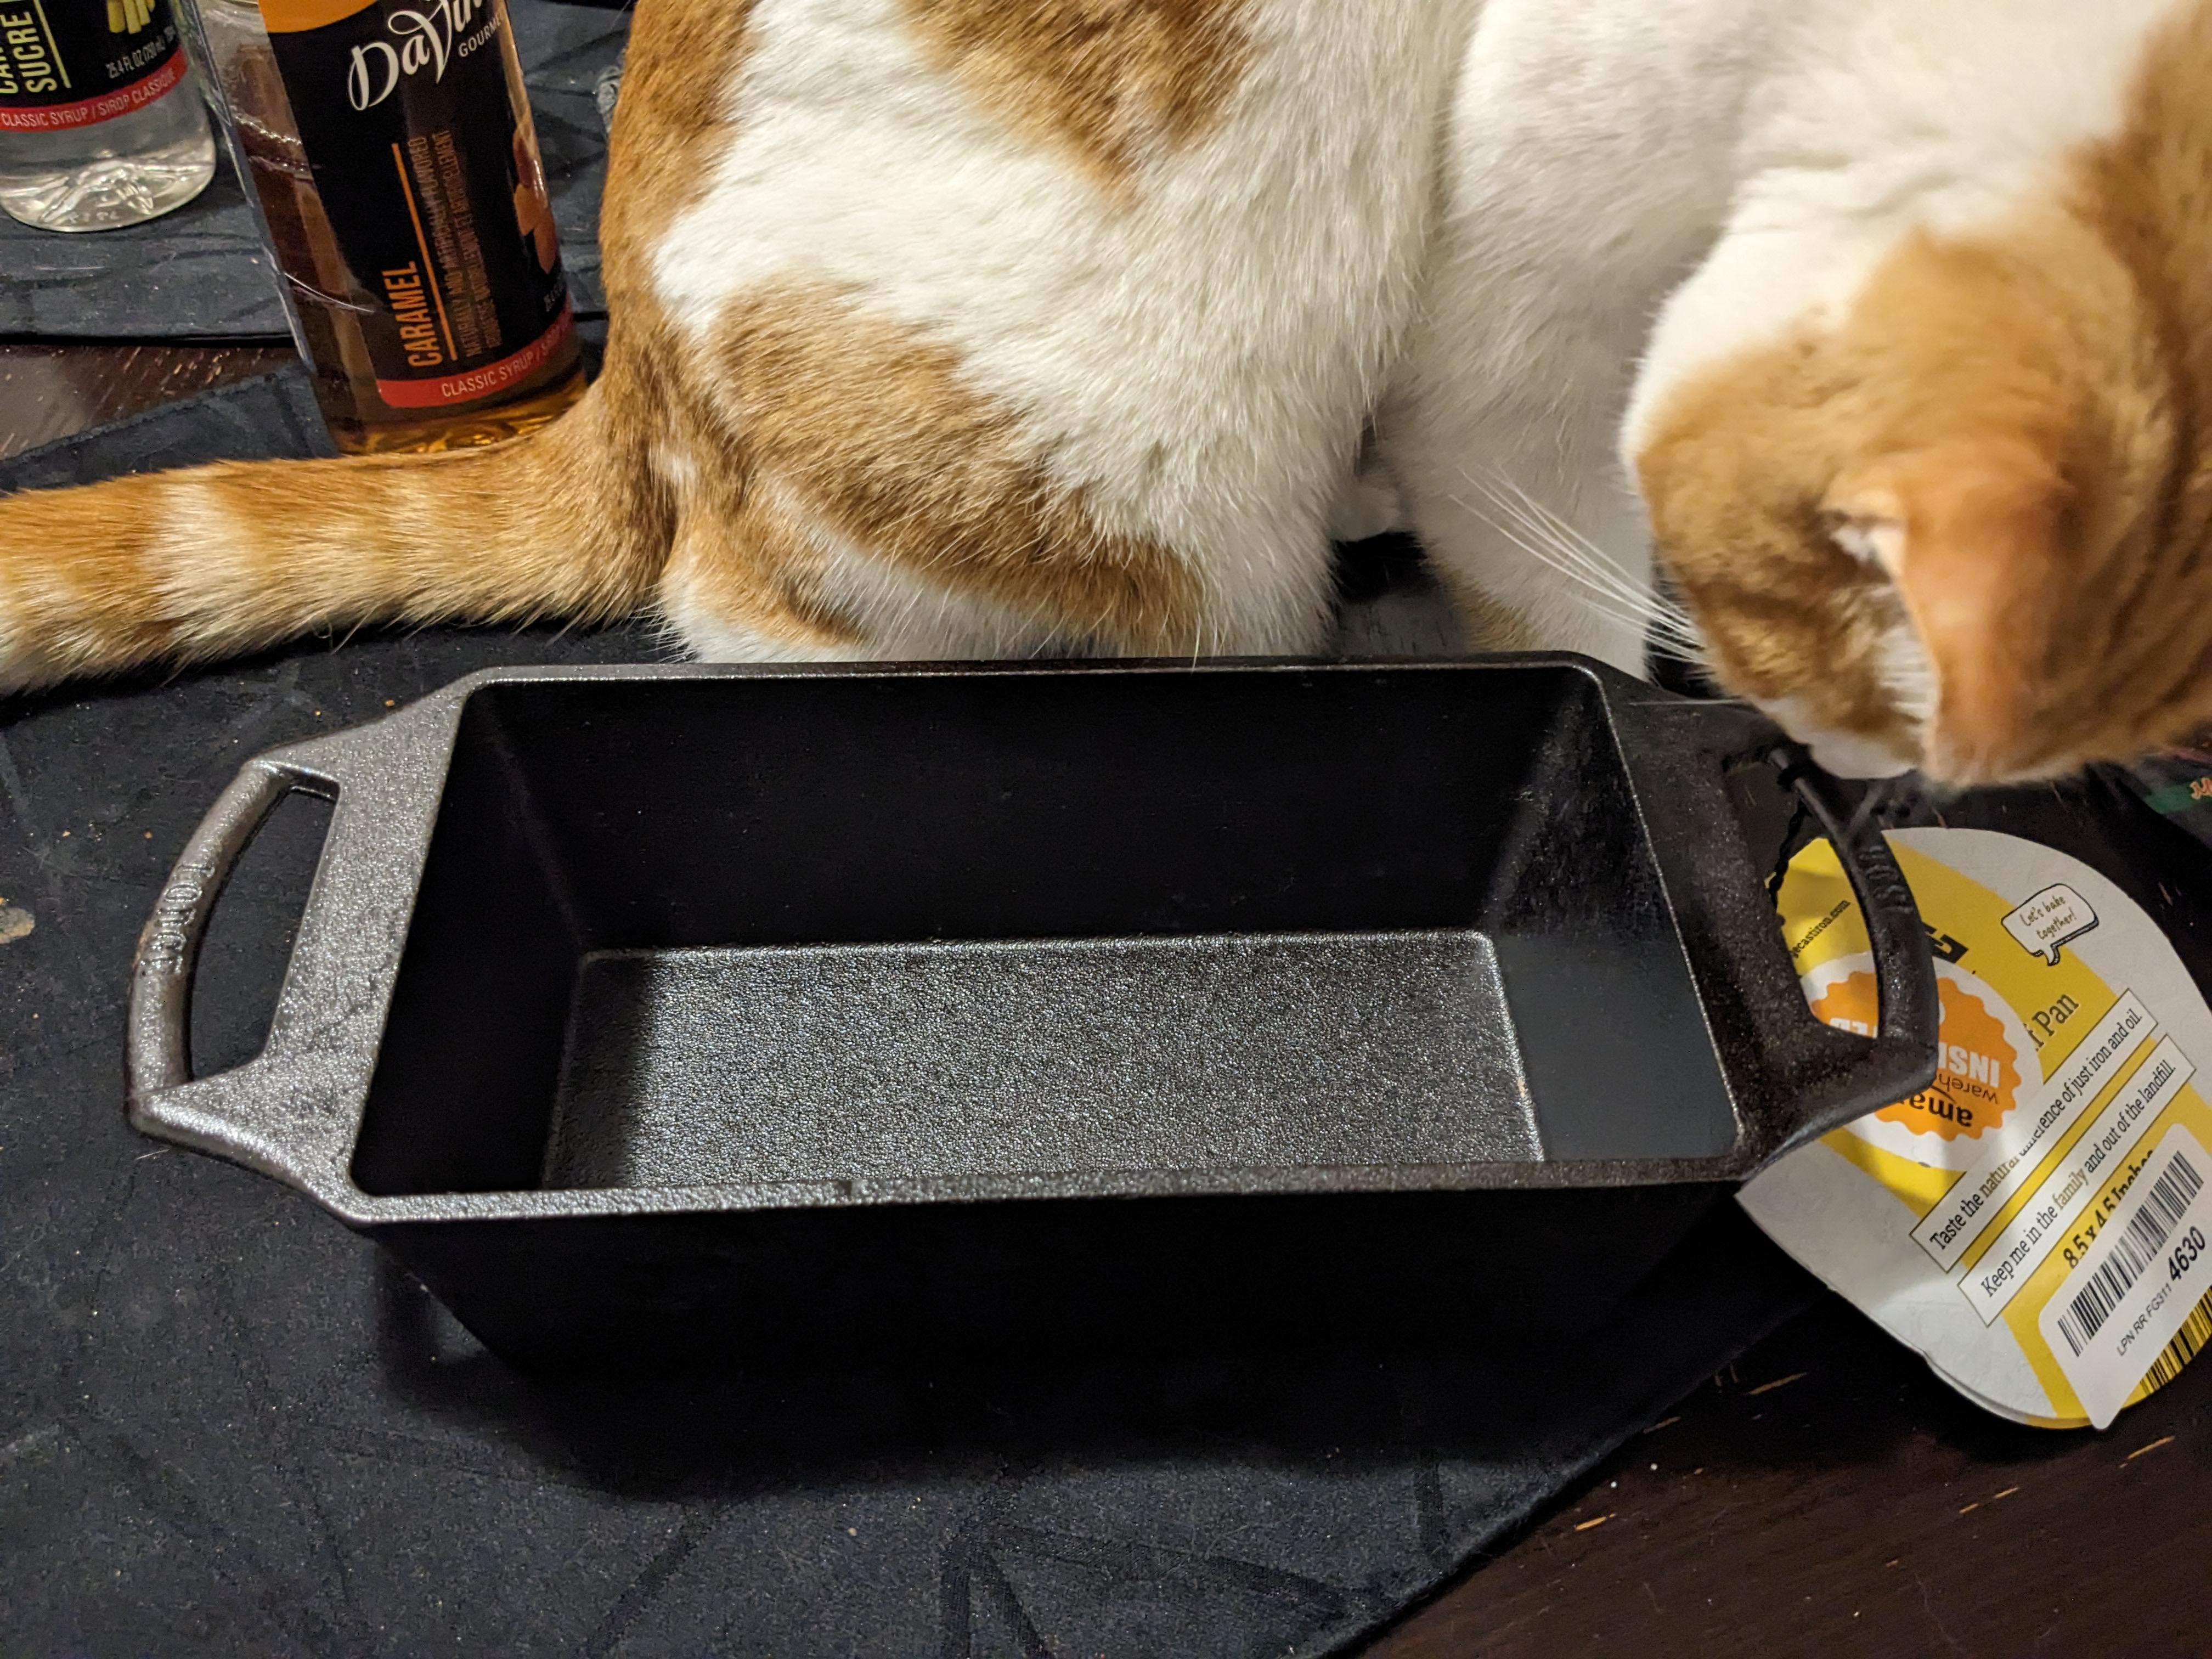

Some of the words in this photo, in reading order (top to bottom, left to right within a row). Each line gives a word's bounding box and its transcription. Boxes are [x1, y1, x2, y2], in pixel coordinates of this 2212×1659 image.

[0, 12, 58, 93] SUCRE
[1, 113, 49, 127] CLASSIC
[49, 107, 88, 125] SYRUP
[99, 95, 131, 116] SIROP
[381, 261, 443, 366] CARAMEL
[441, 371, 496, 397] CLASSIC
[499, 351, 534, 380] SYRUP
[2019, 906, 2044, 926] Let's
[2042, 895, 2066, 912] bake
[2036, 907, 2077, 940] together!
[2032, 994, 2079, 1037] Pan
[2125, 1008, 2143, 1030] oil.
[2107, 1022, 2129, 1049] and
[2085, 1046, 2112, 1071] iron
[2062, 1083, 2076, 1103] of
[2068, 1065, 2094, 1096] just
[1980, 1260, 2015, 1298] Keep
[2009, 1240, 2030, 1266] me
[2023, 1226, 2042, 1245] in
[2036, 1206, 2058, 1230] the
[2052, 1168, 2089, 1211] family
[2085, 1143, 2107, 1173] and
[2102, 1126, 2122, 1151] out
[2117, 1111, 2131, 1133] of
[2124, 1098, 2145, 1120] the
[2137, 1059, 2176, 1103] landfill.
[1960, 1194, 1984, 1218] the
[1929, 1214, 1966, 1250] Taste
[2085, 1225, 2097, 1242] x
[2116, 1329, 2136, 1357] LPN
[2133, 1314, 2148, 1334] RR
[2146, 1282, 2172, 1317] FG311
[2168, 1226, 2206, 1281] 4630
